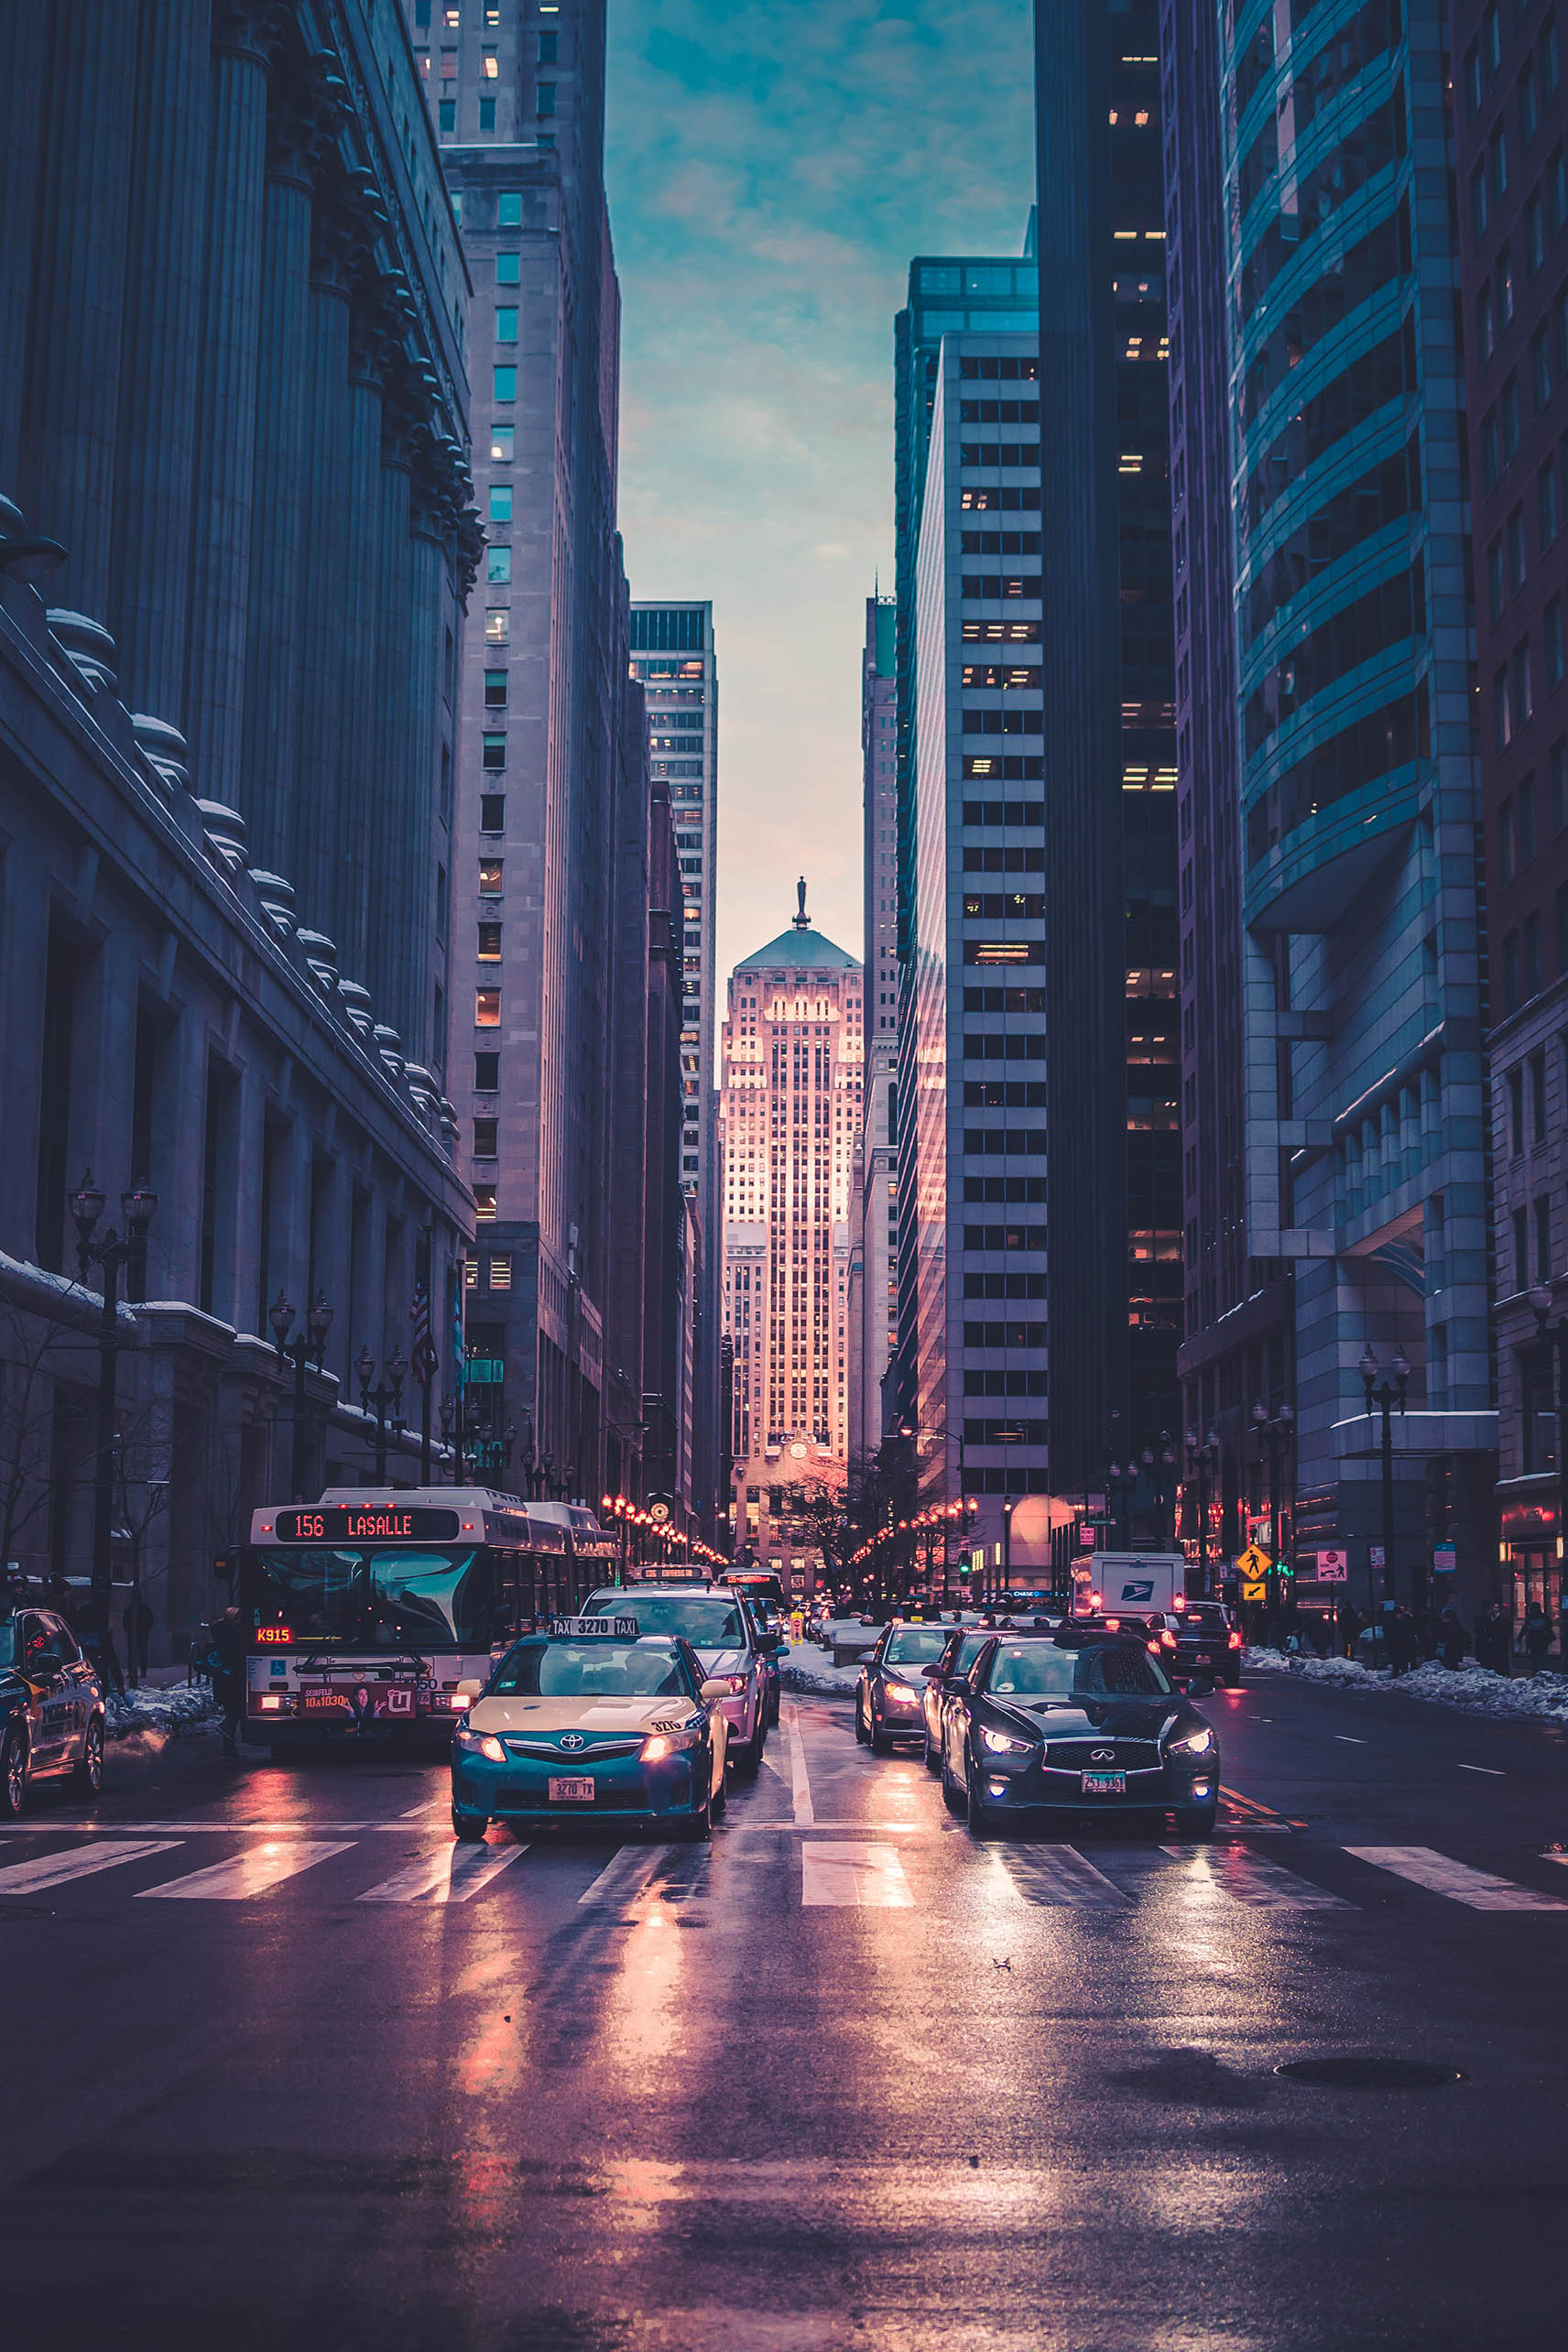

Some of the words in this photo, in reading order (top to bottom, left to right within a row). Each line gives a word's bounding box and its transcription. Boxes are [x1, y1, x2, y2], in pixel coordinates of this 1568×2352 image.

[295, 1515, 324, 1537] 156
[348, 1515, 412, 1536] LASALLE
[578, 1619, 608, 1634] 3270
[615, 1618, 636, 1634] TAXI
[257, 1628, 289, 1641] K915
[557, 1783, 577, 1795] 3270
